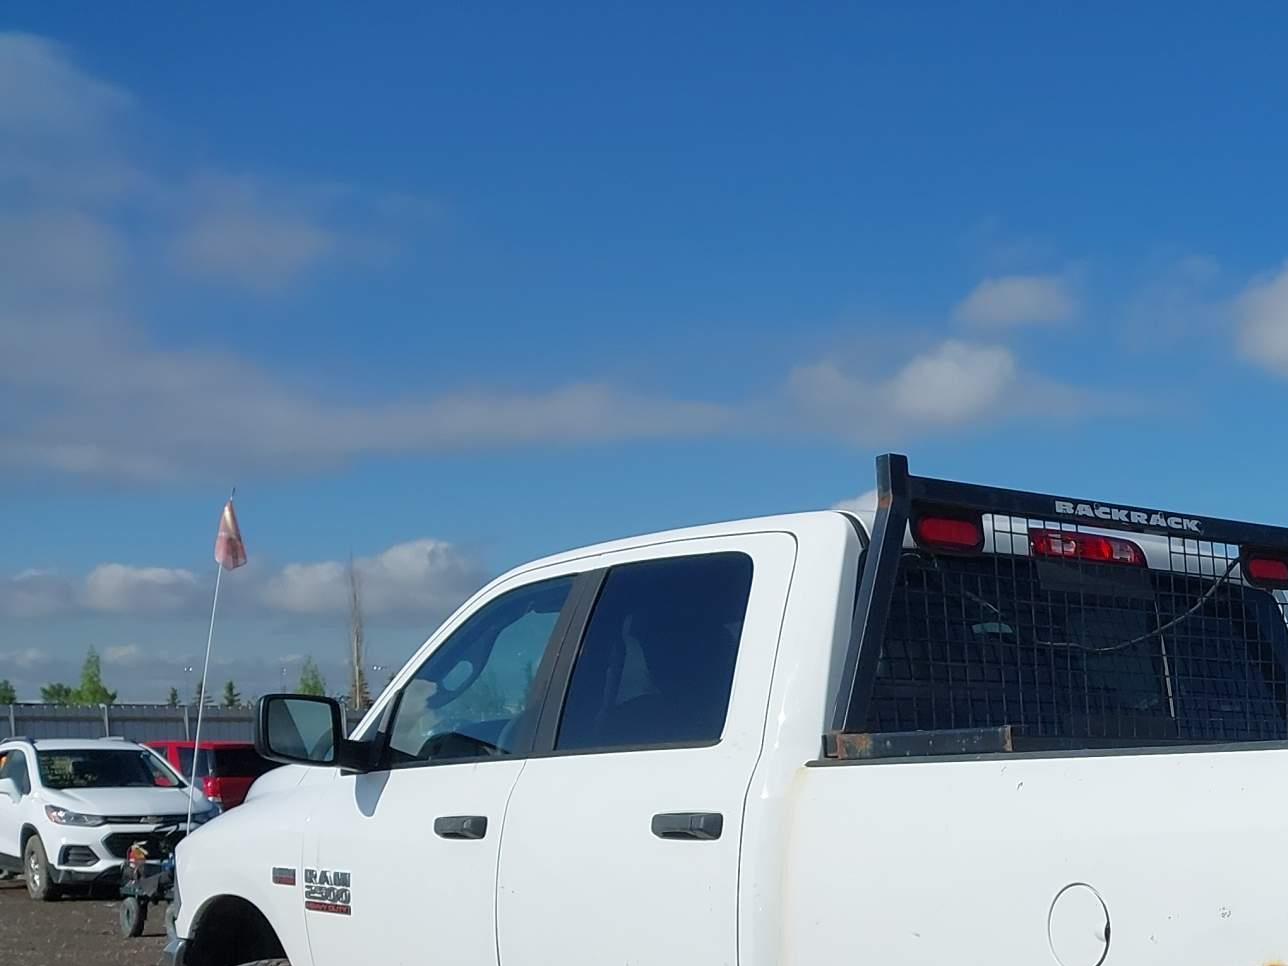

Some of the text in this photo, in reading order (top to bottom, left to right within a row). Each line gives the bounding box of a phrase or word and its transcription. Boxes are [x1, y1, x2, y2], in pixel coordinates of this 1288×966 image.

[1054, 499, 1203, 533] BACKRACK
[304, 868, 351, 888] RAM
[304, 885, 351, 905] 2500
